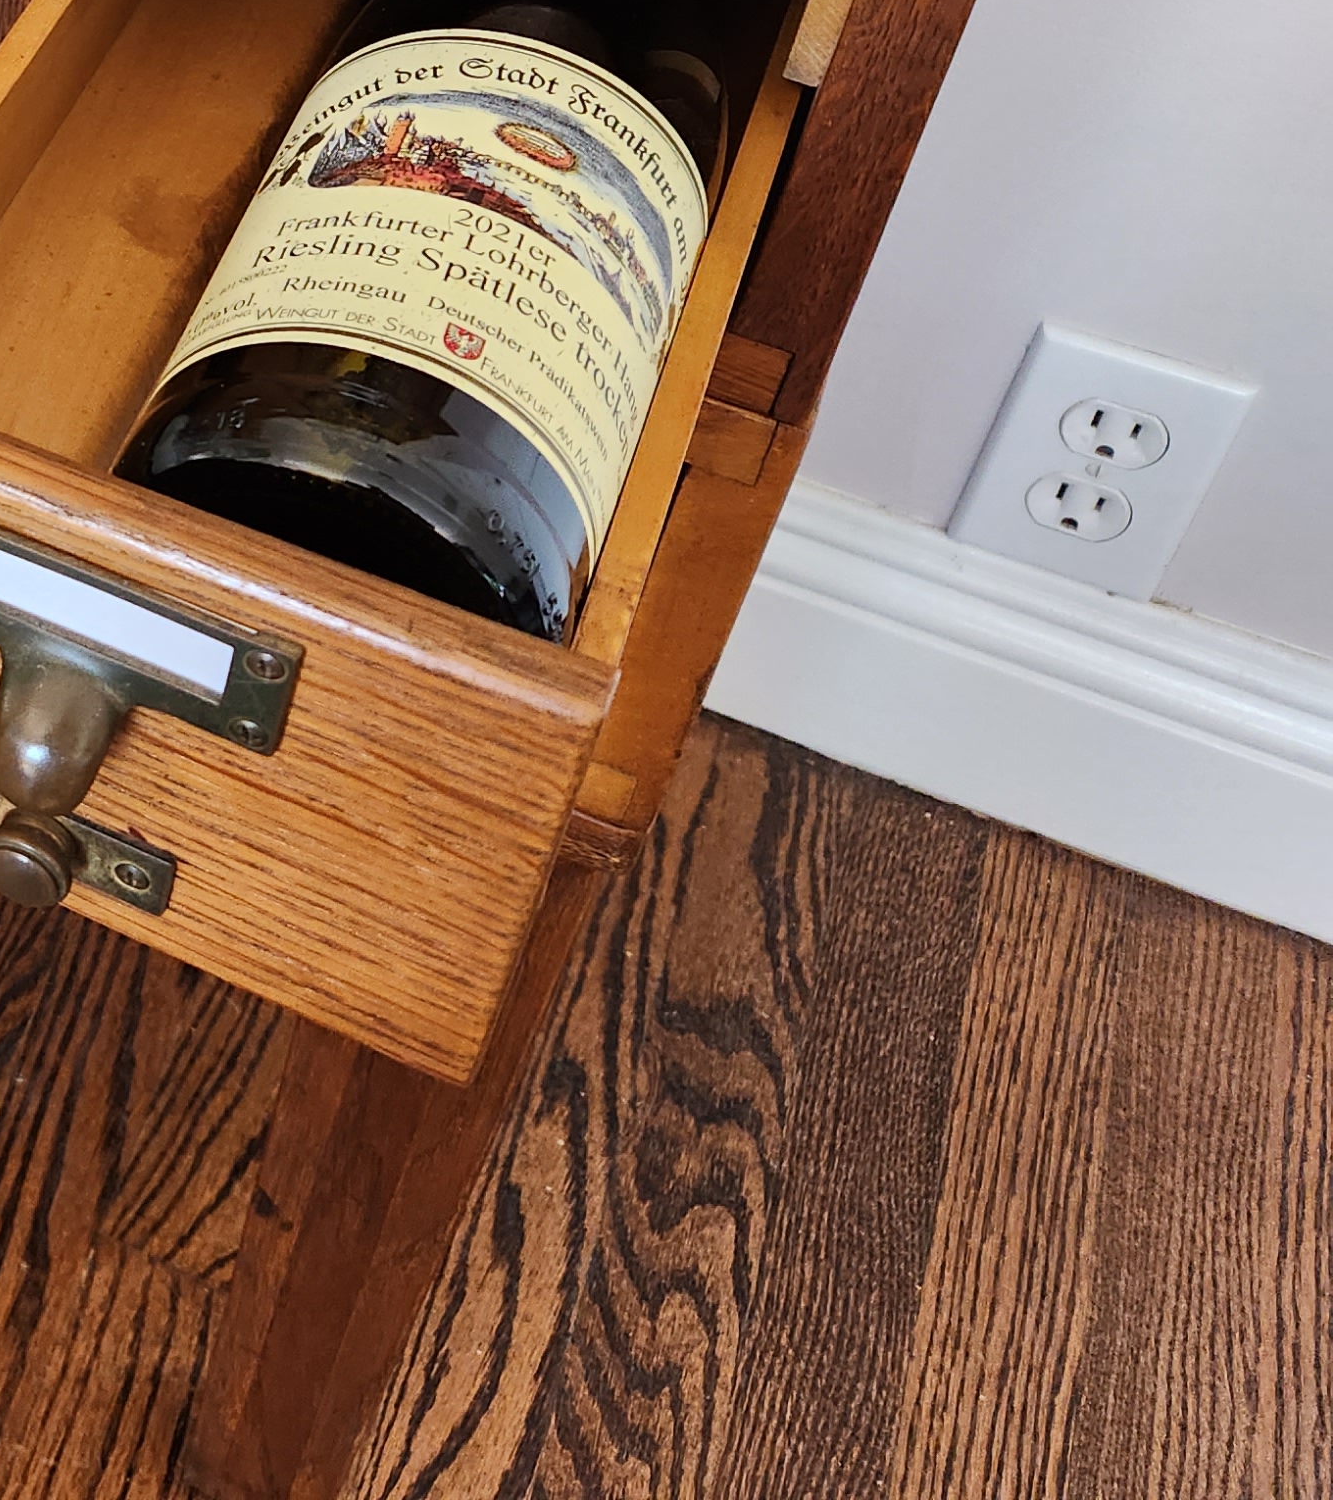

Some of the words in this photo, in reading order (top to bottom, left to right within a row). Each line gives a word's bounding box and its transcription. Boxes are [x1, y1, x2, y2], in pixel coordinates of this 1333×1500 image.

[395, 64, 444, 85] der
[459, 58, 559, 95] Stadt
[568, 83, 678, 211] Frankfurt
[674, 217, 688, 265] am
[454, 209, 557, 269] 2021er
[252, 234, 402, 268] Riesling
[417, 248, 568, 343] Spätlese
[575, 341, 628, 461] trocken
[277, 211, 454, 243] Frankfurter
[464, 234, 613, 352] Lohrberger
[256, 305, 338, 321] WEINGUT
[345, 311, 378, 327] DER
[383, 317, 437, 346] STADT
[480, 355, 554, 425] FRANKFURT
[555, 425, 574, 451] AM
[282, 276, 407, 304] Rheingau
[427, 296, 525, 354] Deutscher
[529, 350, 608, 462] Prädikatswein
